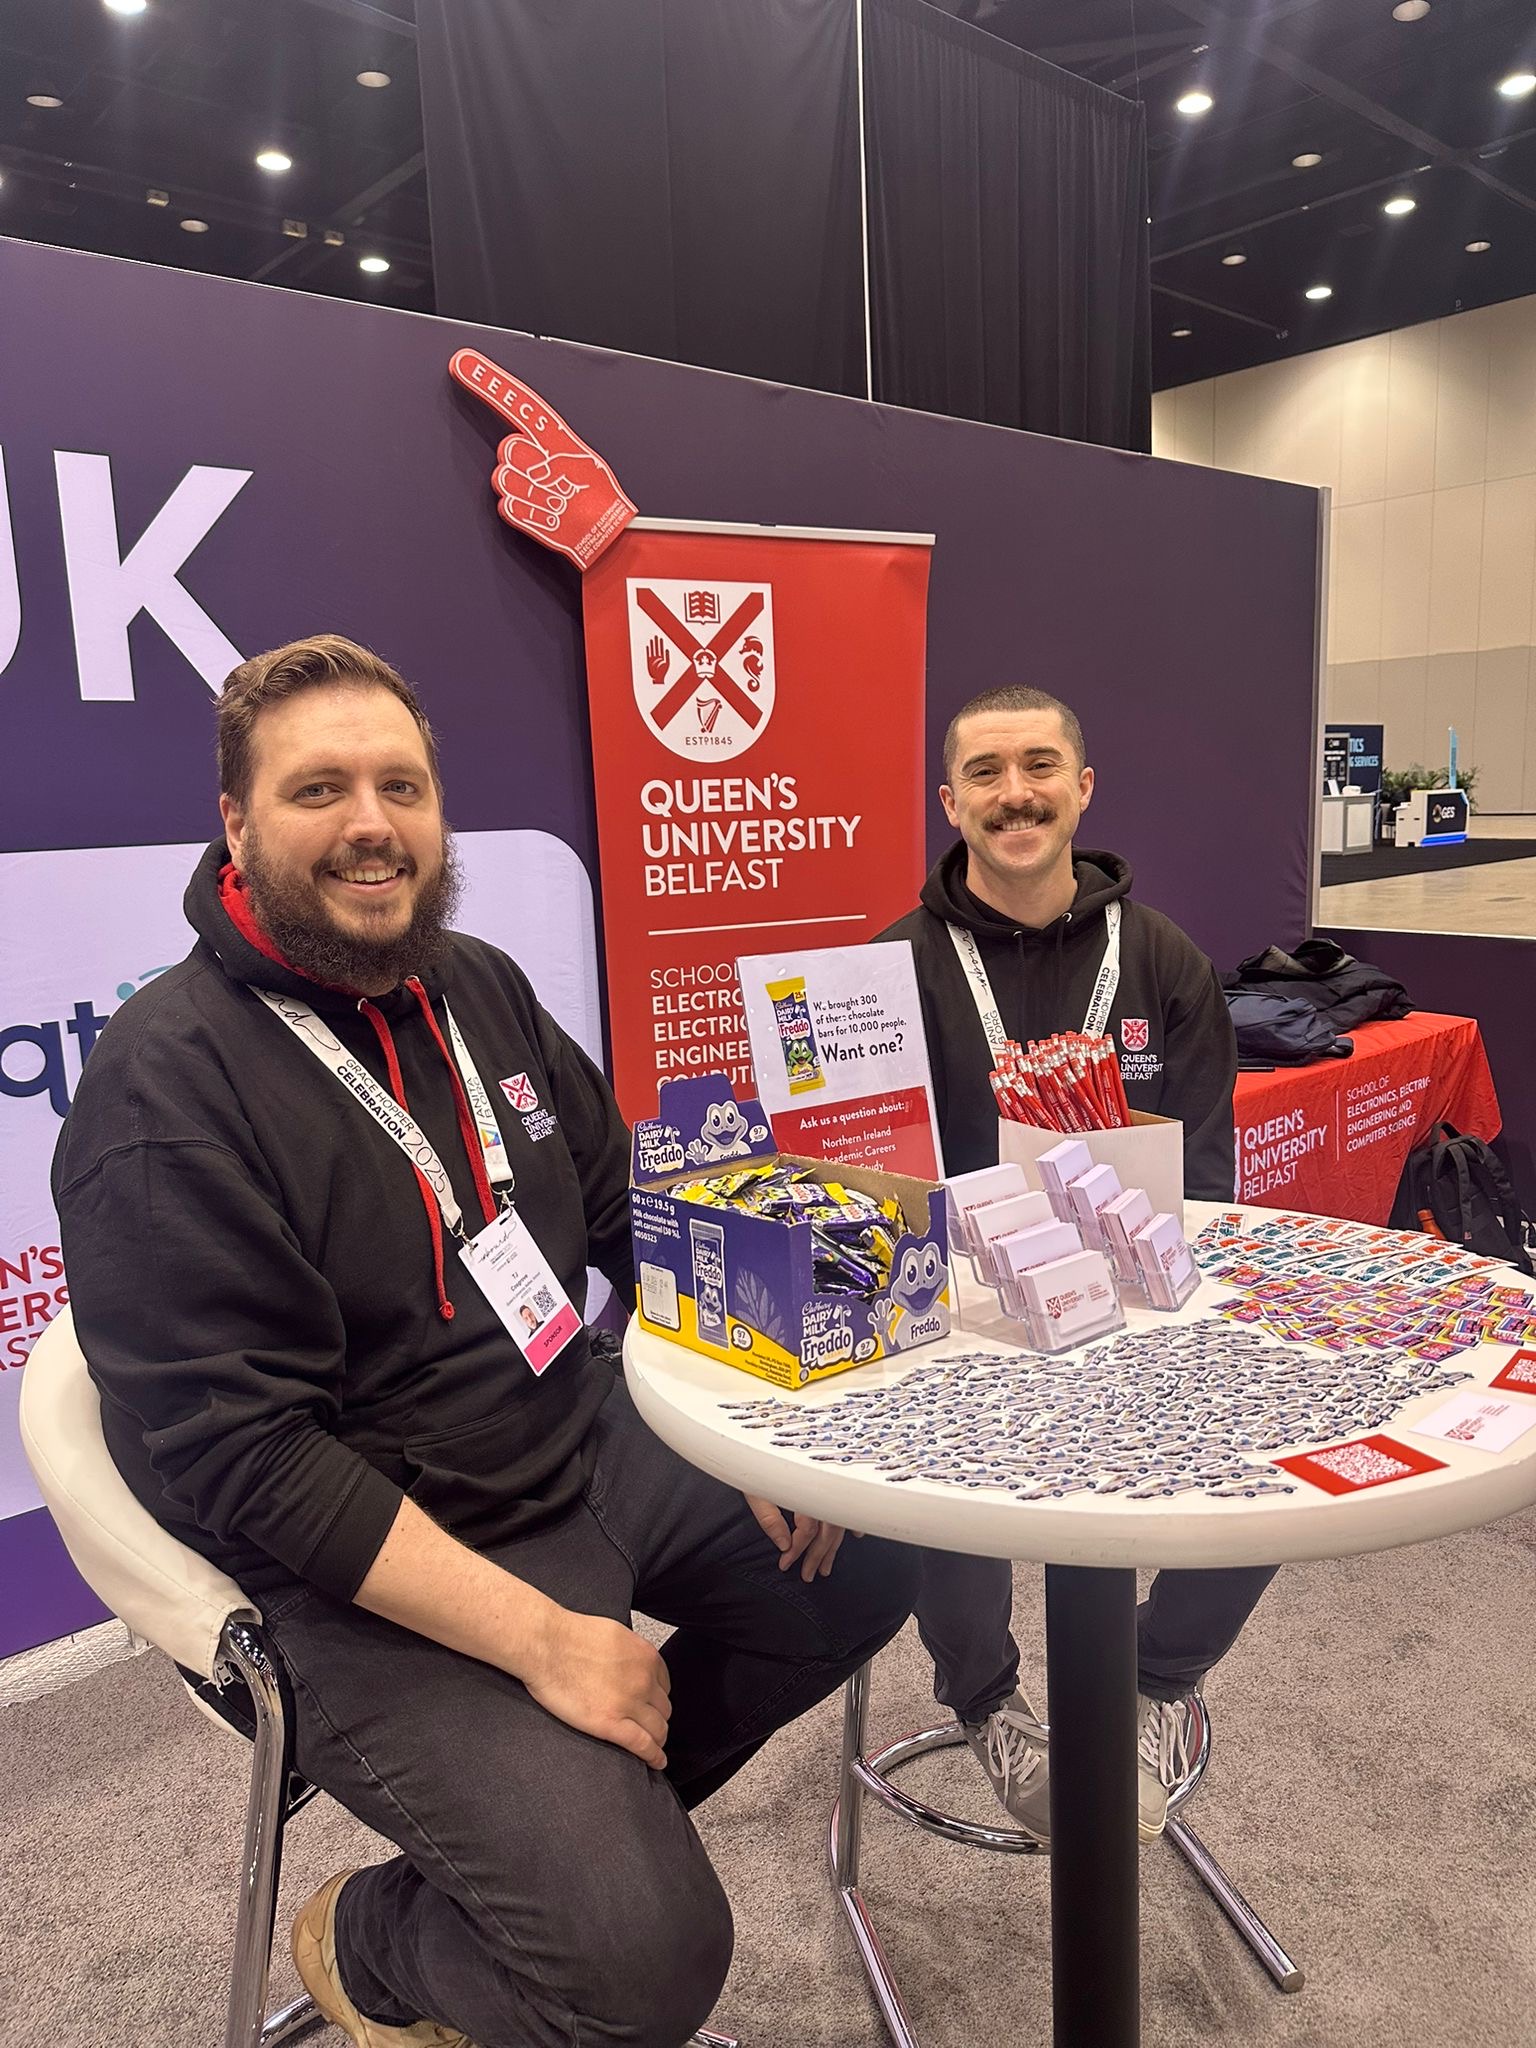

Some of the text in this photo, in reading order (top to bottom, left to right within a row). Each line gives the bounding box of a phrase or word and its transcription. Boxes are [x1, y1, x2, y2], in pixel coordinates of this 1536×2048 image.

[471, 363, 548, 431] EEECS
[0, 445, 254, 702] K
[1354, 755, 1379, 767] SERVICES
[640, 772, 798, 818] QUEEN'S
[1441, 806, 1455, 819] GES
[642, 815, 862, 858] UNIVERSITY
[644, 858, 784, 896] BELFAST
[828, 998, 859, 1012] brought
[861, 994, 878, 1005] 300
[1085, 967, 1110, 1031] CELEBRATION
[1095, 969, 1118, 1032] GRACE HOPPER
[777, 1008, 794, 1016] DAIRY
[816, 1015, 824, 1025] of
[848, 1008, 885, 1020] chocolate
[780, 1021, 809, 1037] Freddo
[818, 1028, 834, 1038] bars
[836, 1025, 847, 1035] for
[849, 1021, 878, 1034] 10,000
[983, 1012, 998, 1045] ANITA
[655, 1040, 750, 1069] ENGINEE
[821, 1032, 904, 1063] Want one?
[1120, 1072, 1153, 1080] BELFAST
[1121, 1063, 1164, 1072] UNIVERSIT
[345, 1059, 415, 1131] GRACE HOPPER
[467, 1077, 485, 1117] ANITA
[1346, 1075, 1390, 1101] SCHOOL OF
[337, 1065, 406, 1140] CELEBRATION
[800, 1116, 818, 1130] Ask
[820, 1118, 831, 1126] us
[839, 1107, 877, 1125] question
[1244, 1108, 1304, 1150] QUEEN'S
[1347, 1106, 1397, 1136] ENGINEERING
[639, 1128, 664, 1140] DAIRY
[753, 1127, 763, 1135] 97
[822, 1125, 892, 1149] Northern Ireland
[1346, 1113, 1417, 1152] COMPUTER SCIENCE
[640, 1139, 661, 1150] MILK
[823, 1143, 897, 1163] Academic Careers
[1244, 1124, 1327, 1177] UNIVERSITY
[402, 1131, 449, 1193] 2025
[641, 1145, 683, 1169] Freddo
[1244, 1161, 1298, 1201] BELFAST
[632, 1193, 640, 1204] 60
[654, 1198, 669, 1212] 19.5
[632, 1208, 679, 1228] Milk chocolate with
[643, 1221, 663, 1234] caramel
[696, 1262, 721, 1282] Freddo
[802, 1301, 832, 1316] Cadbury
[802, 1308, 833, 1327] DAIRY
[737, 1329, 746, 1340] 97
[803, 1321, 828, 1338] MILK
[910, 1317, 941, 1340] Freddo
[803, 1329, 851, 1361] Freddo
[860, 1341, 870, 1351] 97
